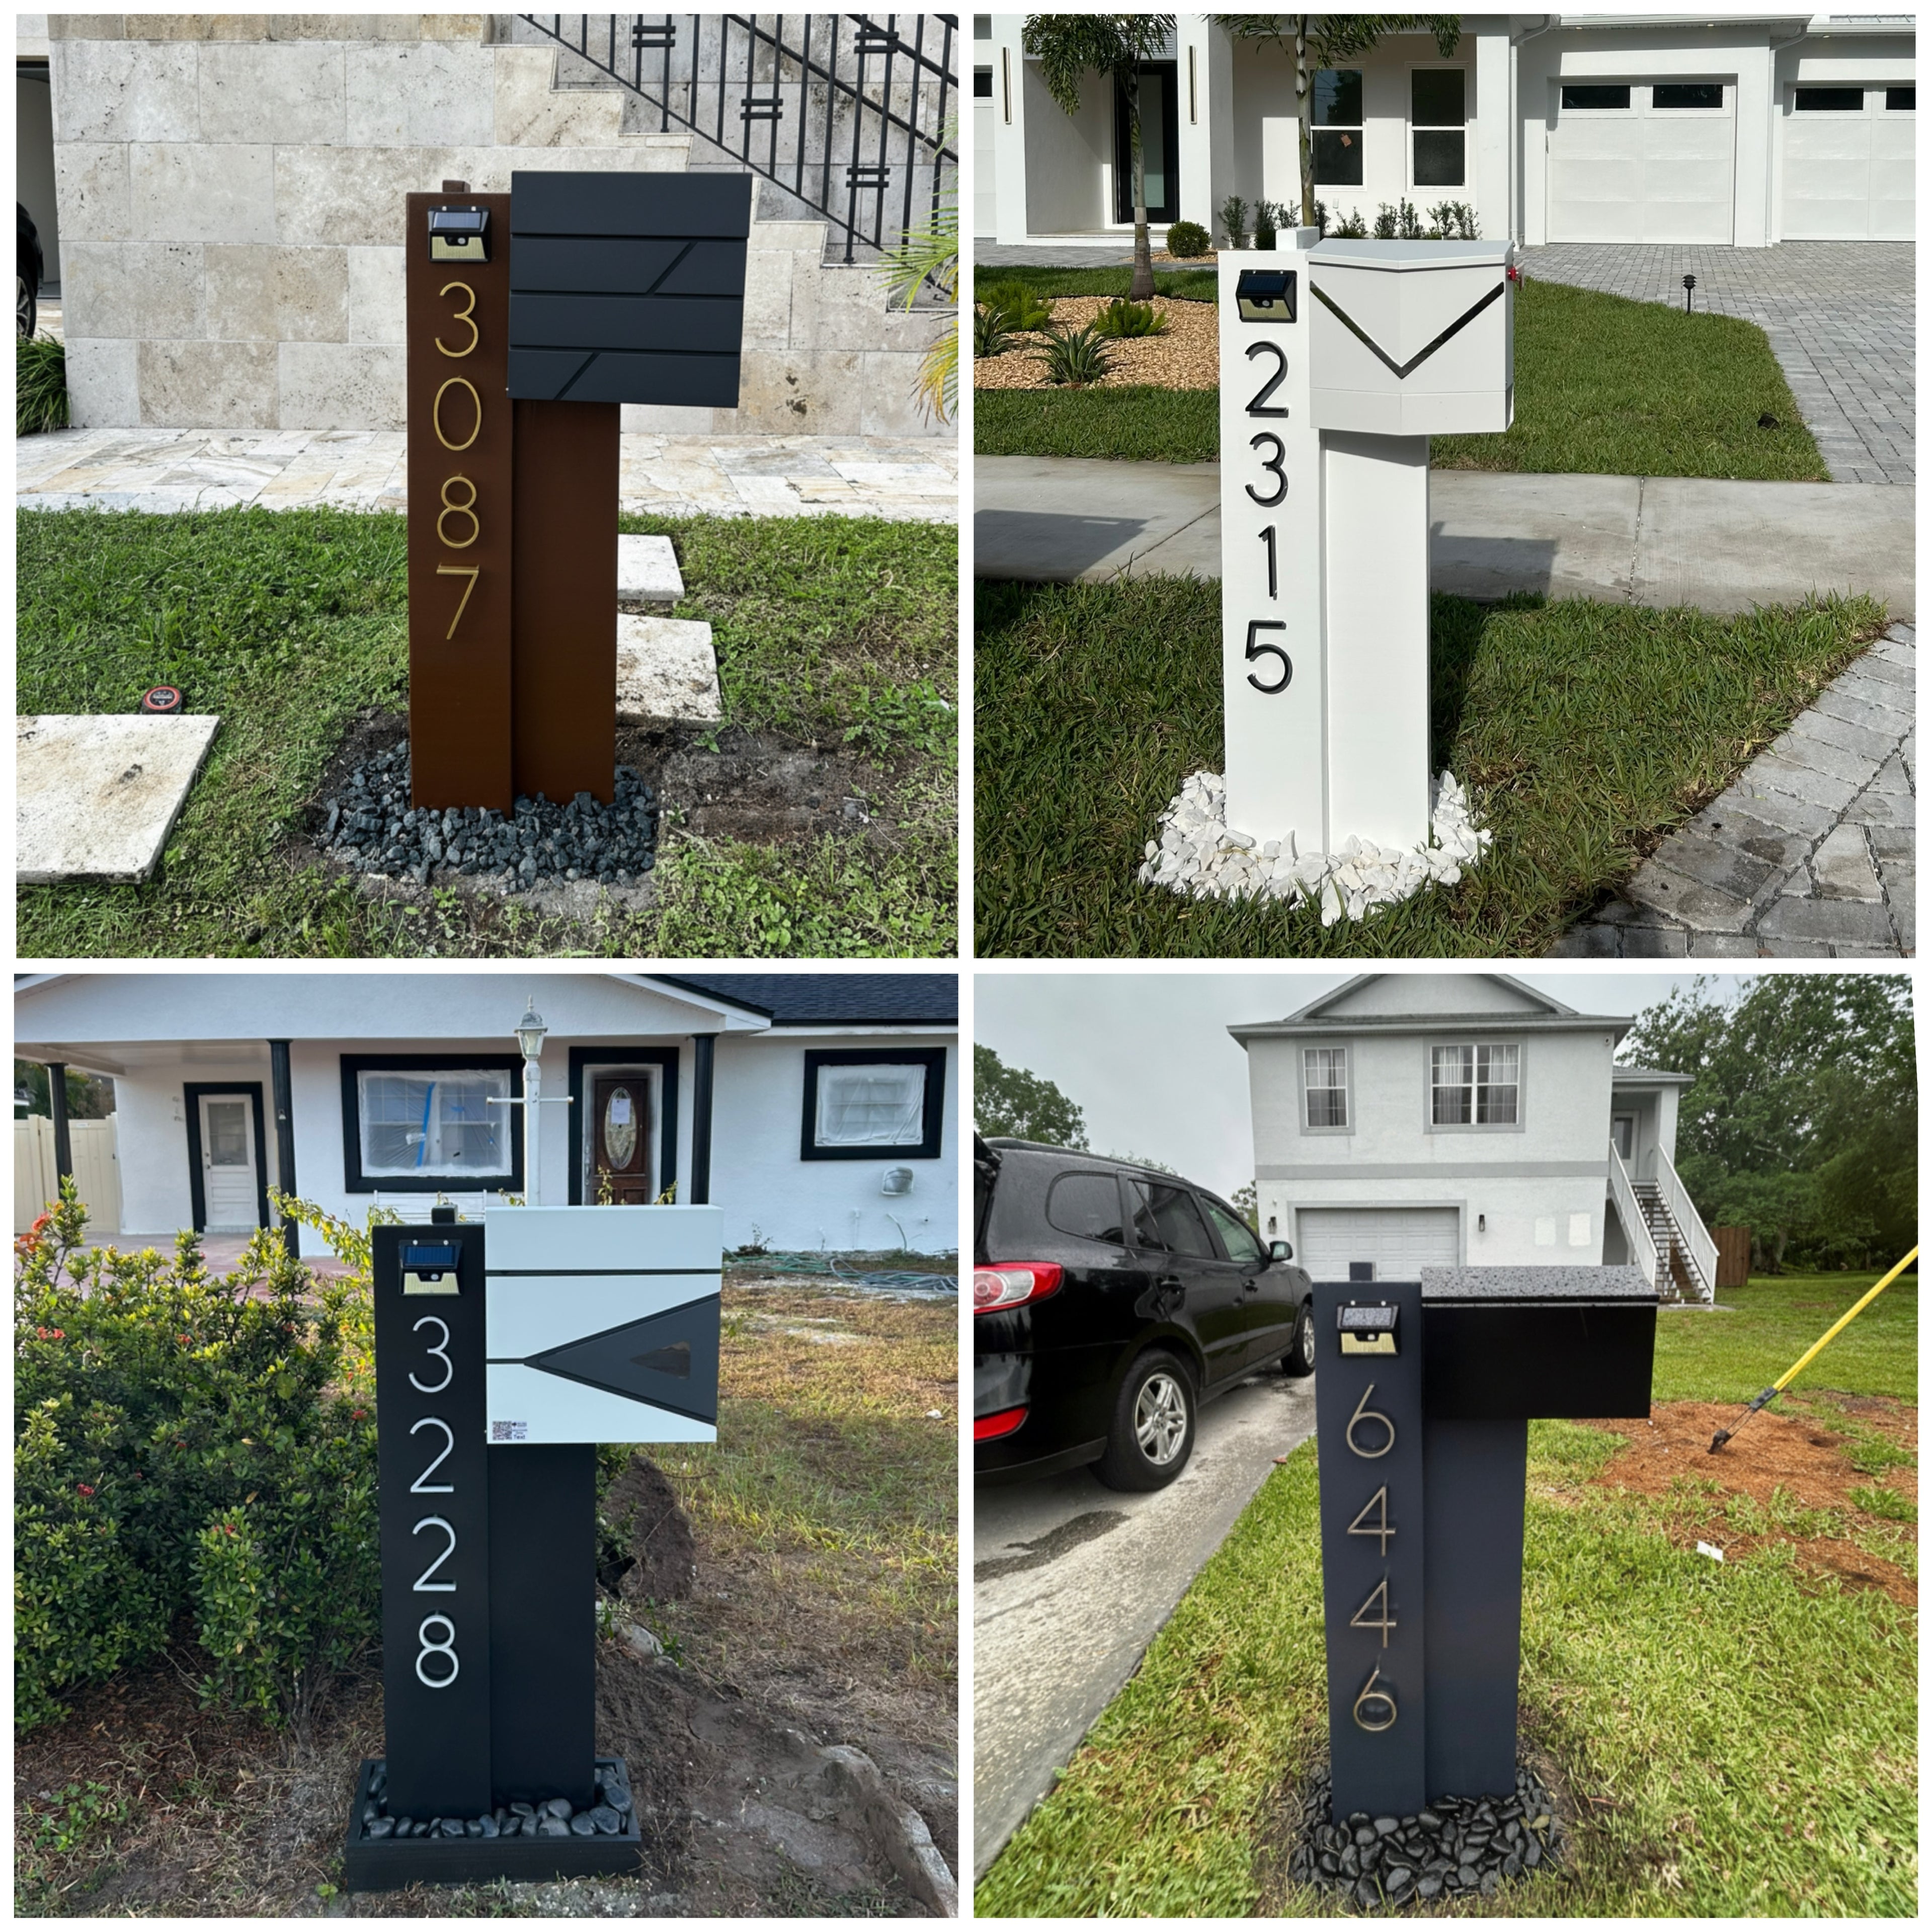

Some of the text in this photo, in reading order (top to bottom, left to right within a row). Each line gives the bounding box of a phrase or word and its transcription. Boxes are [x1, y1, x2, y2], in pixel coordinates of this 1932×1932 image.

[434, 281, 481, 640] 3087
[1245, 341, 1293, 695] 2315
[408, 1315, 459, 1688] 3228
[1346, 1382, 1397, 1732] 6446
